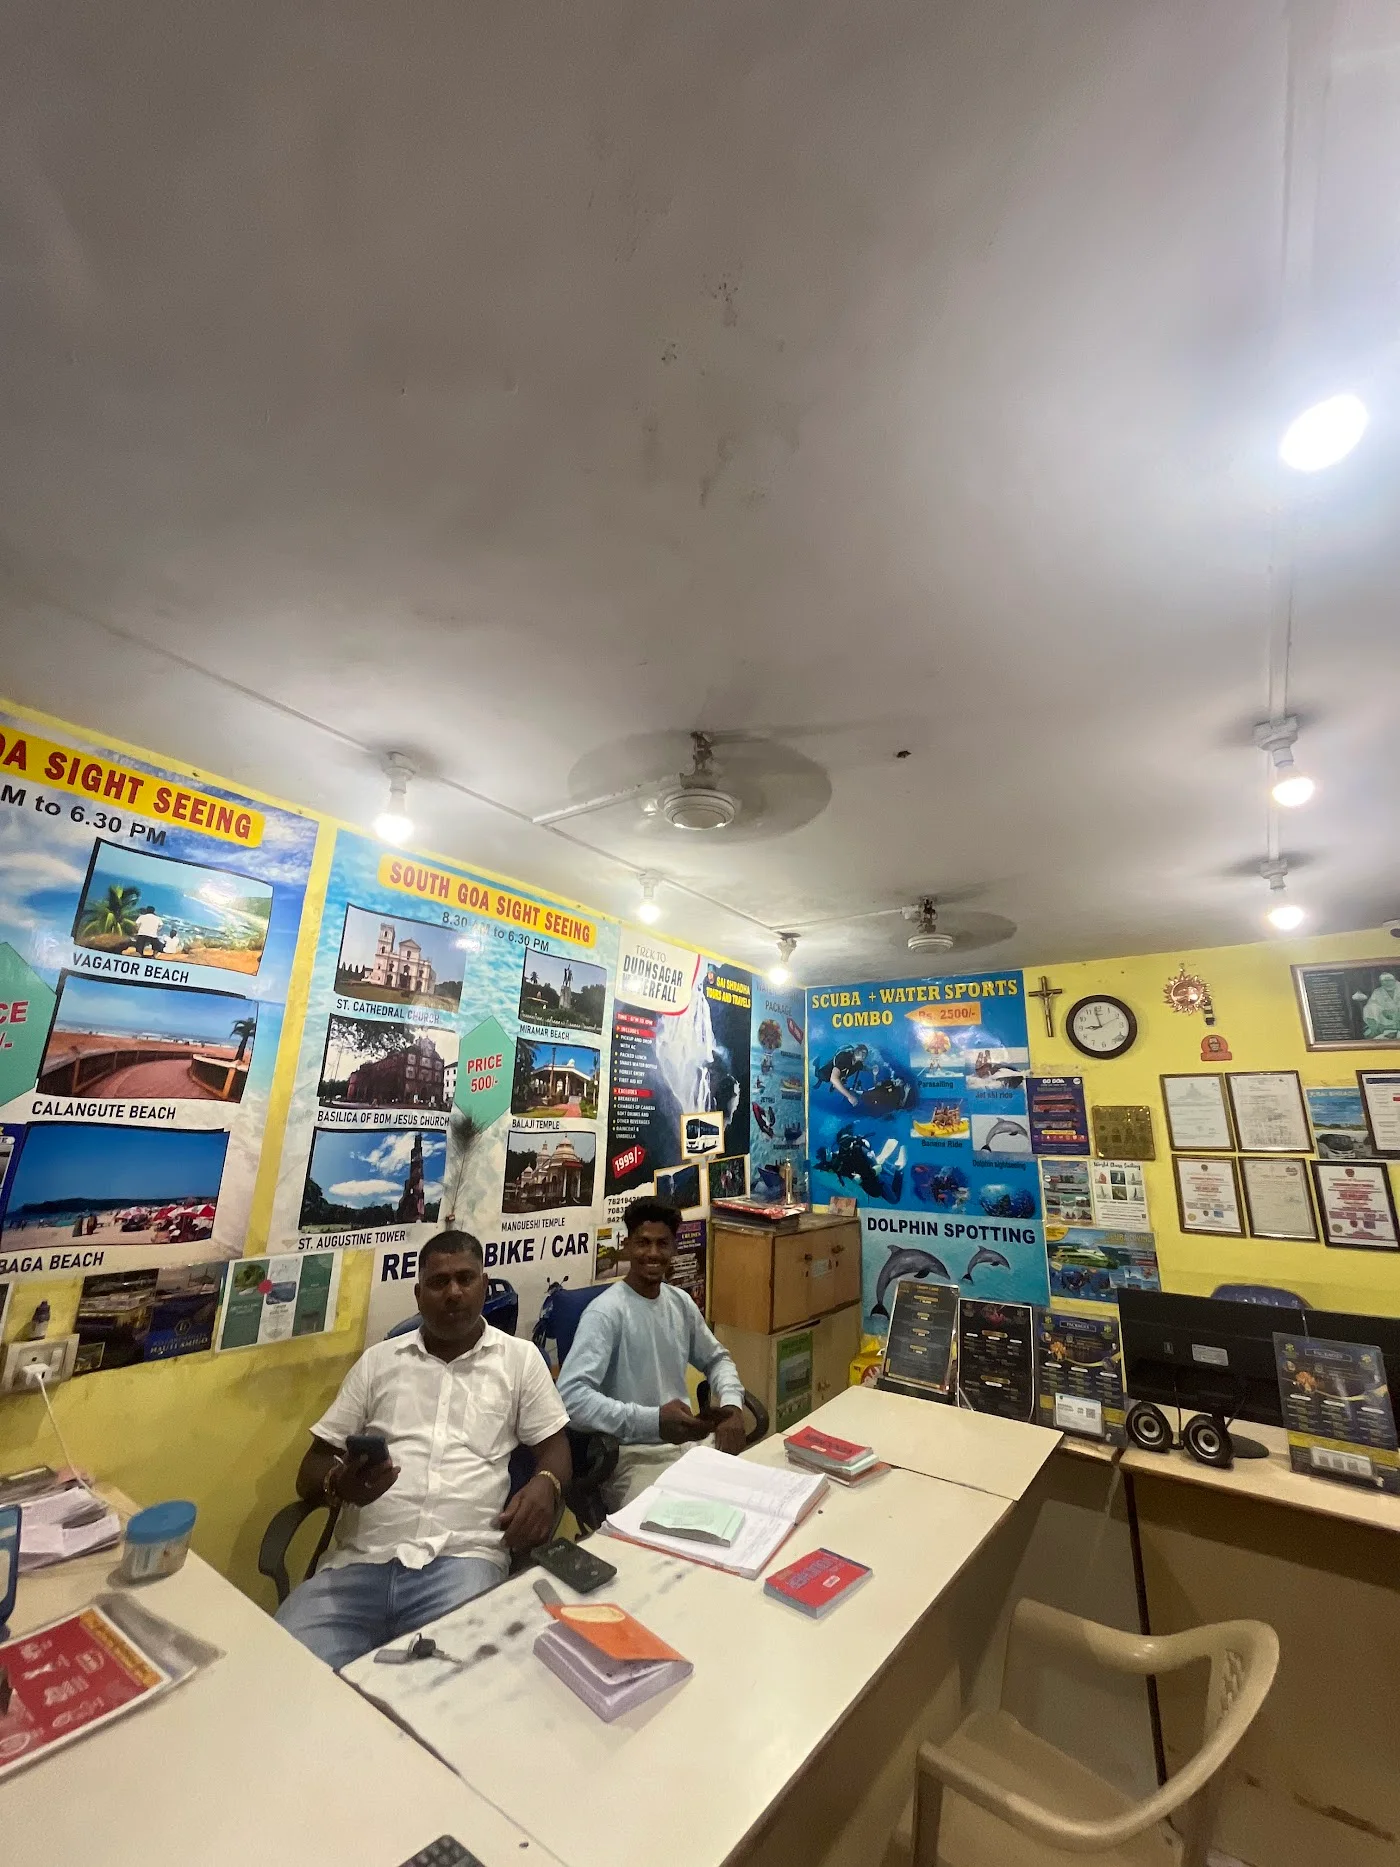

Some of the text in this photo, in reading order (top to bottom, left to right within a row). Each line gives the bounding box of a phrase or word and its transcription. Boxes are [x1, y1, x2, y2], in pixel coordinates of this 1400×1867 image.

[0, 732, 252, 840] A SIGHT SEEING
[35, 794, 61, 816] to
[70, 805, 122, 834] 6.30
[130, 822, 167, 846] PM
[389, 861, 591, 943] SOUTH GOA SIGHT SEEING
[442, 911, 468, 928] 8.30
[493, 926, 505, 939] to
[508, 930, 531, 946] 6.30
[533, 938, 550, 952] PM
[636, 945, 667, 964] TREK TO
[73, 952, 190, 984] VAGATOR BEACH
[623, 955, 684, 988] DUDHSAGAR
[722, 991, 732, 1003] AND
[811, 991, 861, 1009] SCUBA
[868, 992, 876, 1004] +
[879, 985, 941, 1004] WATER
[944, 979, 1019, 1001] SPORTS
[336, 998, 441, 1025] ST. CATHEDRAL CHURCH
[831, 1010, 893, 1029] COMBO
[940, 1008, 976, 1020] 2500/-
[519, 1024, 570, 1041] MIRAMAR BEACH
[467, 1054, 503, 1074] PRICE
[471, 1075, 499, 1093] 500/-
[918, 1080, 954, 1089] Parasailing
[31, 1100, 177, 1120] CALANGUTE BEACH
[317, 1110, 450, 1127] BASILICA OF BOM JESUS CHURCH
[512, 1119, 560, 1130] BALAJI TEMPLE
[921, 1139, 963, 1148] Banana Ride
[615, 1147, 642, 1171] 1999/-
[501, 1217, 566, 1232] MANGUESHI TEMPLE
[867, 1217, 938, 1236] DOLPHIN
[944, 1223, 1036, 1244] SPOTTING
[298, 1230, 405, 1250] ST. AUGUSTINE TOWER
[0, 1251, 105, 1275] BAGA BEACH
[381, 1231, 589, 1282] RE BIKE / CAR
